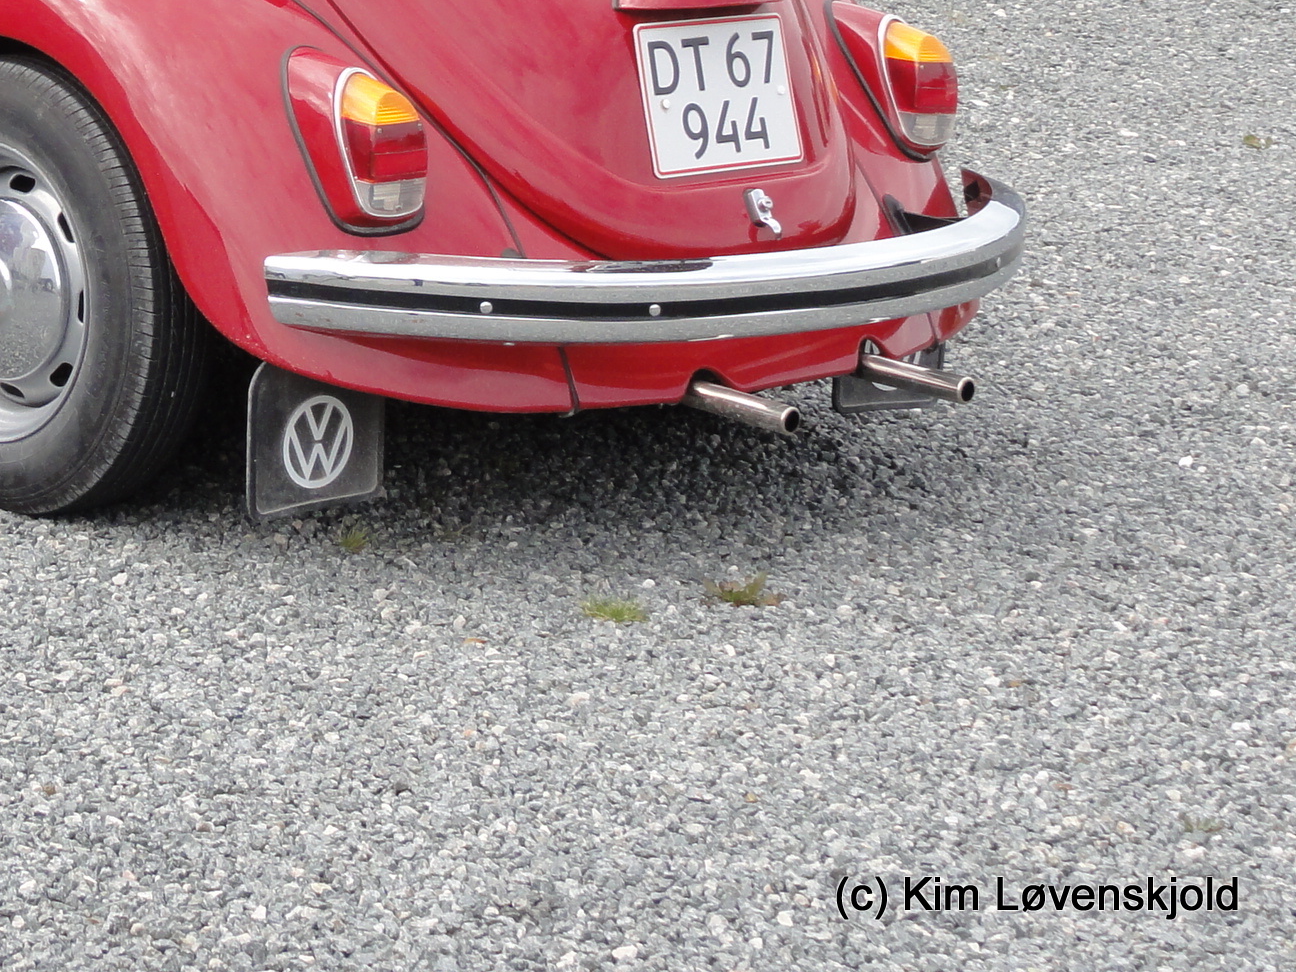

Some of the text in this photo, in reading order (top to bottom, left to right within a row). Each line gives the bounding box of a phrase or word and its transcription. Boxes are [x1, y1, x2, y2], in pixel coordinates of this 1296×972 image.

[647, 30, 774, 96] DT 67
[682, 96, 771, 160] 944
[285, 397, 352, 486] VW
